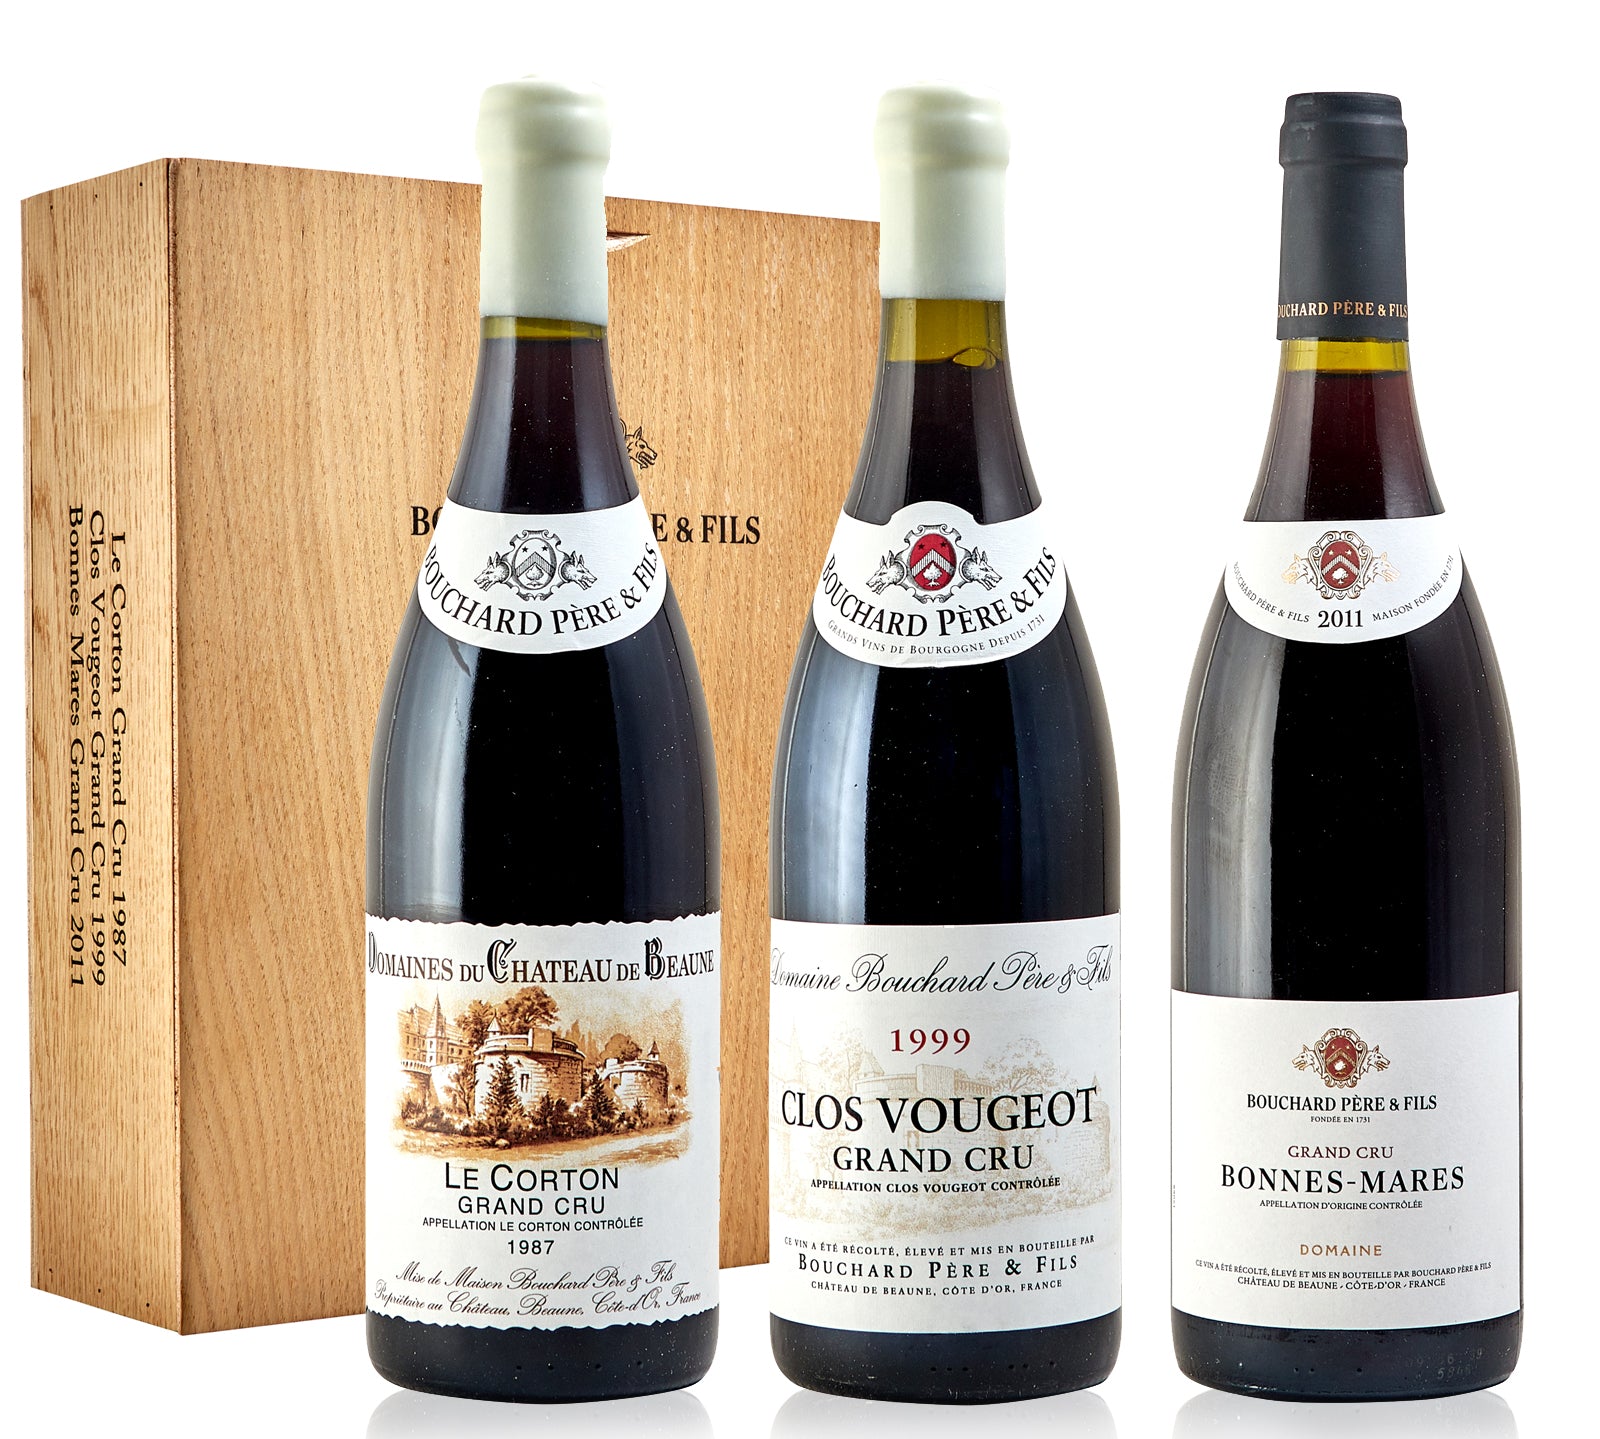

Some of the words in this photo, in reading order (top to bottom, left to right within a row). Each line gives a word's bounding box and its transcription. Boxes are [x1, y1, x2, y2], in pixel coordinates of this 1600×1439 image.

[1333, 299, 1374, 316] PÈRE
[1377, 303, 1386, 317] &
[1389, 303, 1408, 318] FILS
[89, 510, 105, 580] Clos
[676, 516, 694, 543] &
[701, 515, 761, 544] FILS
[69, 504, 84, 617] Bonnes
[111, 532, 127, 573] Le
[424, 544, 543, 636] BOUCHARD
[550, 597, 621, 635] PÈRE
[620, 589, 643, 610] &
[633, 542, 658, 592] FILS
[822, 553, 928, 637] BOUCHARD
[936, 599, 1013, 637] PÈRE
[1010, 590, 1035, 613] &
[1023, 547, 1056, 599] FILS
[1372, 602, 1413, 621] MAISON
[1413, 580, 1443, 607] FONDÉE
[1277, 609, 1286, 617] &
[1287, 611, 1310, 623] FILS
[1317, 609, 1363, 628] 2011
[111, 583, 127, 694] Corton
[828, 619, 858, 645] GRANDS
[862, 638, 885, 652] VINS
[890, 645, 904, 654] DE
[910, 642, 986, 655] BOURGOGNE
[989, 629, 1026, 648] DEPUIS
[1028, 614, 1045, 632] 1731
[86, 590, 105, 721] Vougeot
[70, 632, 84, 726] Mares
[112, 707, 127, 806] Grand
[70, 737, 85, 836] Grand
[90, 731, 106, 829] Grand
[112, 818, 127, 878] Cru
[70, 846, 85, 903] Cru
[91, 841, 106, 900] Cru
[112, 889, 127, 967] 1987
[71, 916, 85, 988] 2011
[91, 914, 106, 987] 1999
[368, 931, 453, 982] DOMAINES
[460, 964, 484, 983] DU
[487, 938, 612, 984] CHATEAU
[616, 963, 640, 981] DE
[644, 936, 715, 981] BEAUNE
[771, 946, 841, 991] Domaine
[846, 953, 995, 993] Bouchard
[993, 951, 1059, 991] Père
[1058, 963, 1075, 994] &
[1076, 944, 1113, 991] Fils
[891, 1028, 971, 1055] 1999
[782, 1090, 863, 1132] CLOS
[876, 1085, 1098, 1134] VOUGEOT
[1247, 1093, 1336, 1111] BOUCHARD
[1341, 1095, 1385, 1112] PÈRE
[1390, 1097, 1400, 1111] &
[1404, 1094, 1437, 1110] FILS
[1310, 1115, 1341, 1123] FONDÉE
[833, 1146, 951, 1173] GRAND
[965, 1145, 1034, 1170] CRU
[1288, 1146, 1350, 1159] GRAND
[1356, 1147, 1394, 1159] CRU
[445, 1162, 479, 1190] LE
[491, 1164, 620, 1192] CORTON
[811, 1179, 881, 1193] APPELLATION
[886, 1182, 919, 1193] CLOS
[923, 1182, 987, 1193] VOUGEOT
[990, 1176, 1061, 1191] CONTRÔLÉE
[1221, 1164, 1465, 1194] BONNES-MARES
[458, 1196, 543, 1215] GRAND
[555, 1196, 606, 1215] CRU
[1259, 1200, 1319, 1209] APPELLATION
[1321, 1202, 1368, 1210] D'ORIGINE
[1369, 1199, 1423, 1210] CONTRÔLÉE
[422, 1216, 496, 1232] APPELLATION
[500, 1221, 515, 1232] LE
[518, 1221, 570, 1232] CORTON
[574, 1216, 644, 1231] CONTRÔLÉE
[507, 1239, 555, 1255] 1987
[784, 1236, 793, 1246] CE
[794, 1238, 808, 1248] VIN
[811, 1242, 817, 1250] A
[820, 1241, 839, 1253] ÉTÉ
[843, 1243, 900, 1257] RÉCOLTÉ,
[904, 1245, 945, 1256] ÉLEVÉ
[950, 1247, 965, 1256] ET
[971, 1246, 992, 1255] MIS
[998, 1245, 1014, 1254] EN
[1018, 1237, 1078, 1253] BOUTEILLE
[1080, 1234, 1095, 1245] PAR
[1300, 1244, 1382, 1256] DOMAINE
[396, 1261, 426, 1284] Mise
[427, 1271, 441, 1286] de
[444, 1265, 503, 1290] Maison
[507, 1266, 595, 1291] Bouchard
[627, 1274, 642, 1292] &
[645, 1260, 677, 1284] Fils
[799, 1253, 913, 1279] BOUCHARD
[929, 1255, 990, 1279] PÈRE
[1005, 1258, 1022, 1276] &
[1036, 1254, 1078, 1274] FILS
[1196, 1259, 1203, 1267] CE
[1203, 1261, 1214, 1269] VIN
[1220, 1262, 1233, 1272] ÉTÉ
[1234, 1265, 1270, 1276] RÉCOLTÉ,
[1271, 1268, 1297, 1277] ÉLEVÉ
[1342, 1271, 1392, 1279] BOUTEILLE
[1394, 1270, 1410, 1278] PAR
[1411, 1267, 1457, 1278] BOUCHARD
[1457, 1264, 1473, 1273] PÈRE
[1479, 1262, 1492, 1271] FILS
[427, 1302, 443, 1310] au
[447, 1290, 511, 1316] Château,
[517, 1293, 584, 1316] Beaune,
[666, 1282, 701, 1307] France
[811, 1280, 858, 1294] CHÂTEAU
[863, 1285, 878, 1294] DE
[883, 1285, 937, 1296] BEAUNE,
[942, 1283, 976, 1295] CÔTE
[981, 1283, 1016, 1294] D'OR,
[1020, 1279, 1063, 1292] FRANCE
[1237, 1276, 1280, 1287] CHÂTEAU
[1283, 1280, 1296, 1289] DE
[1298, 1281, 1338, 1290] BEAUNE
[1345, 1280, 1401, 1290] CÔTE-D'OR
[1408, 1278, 1446, 1289] FRANCE
